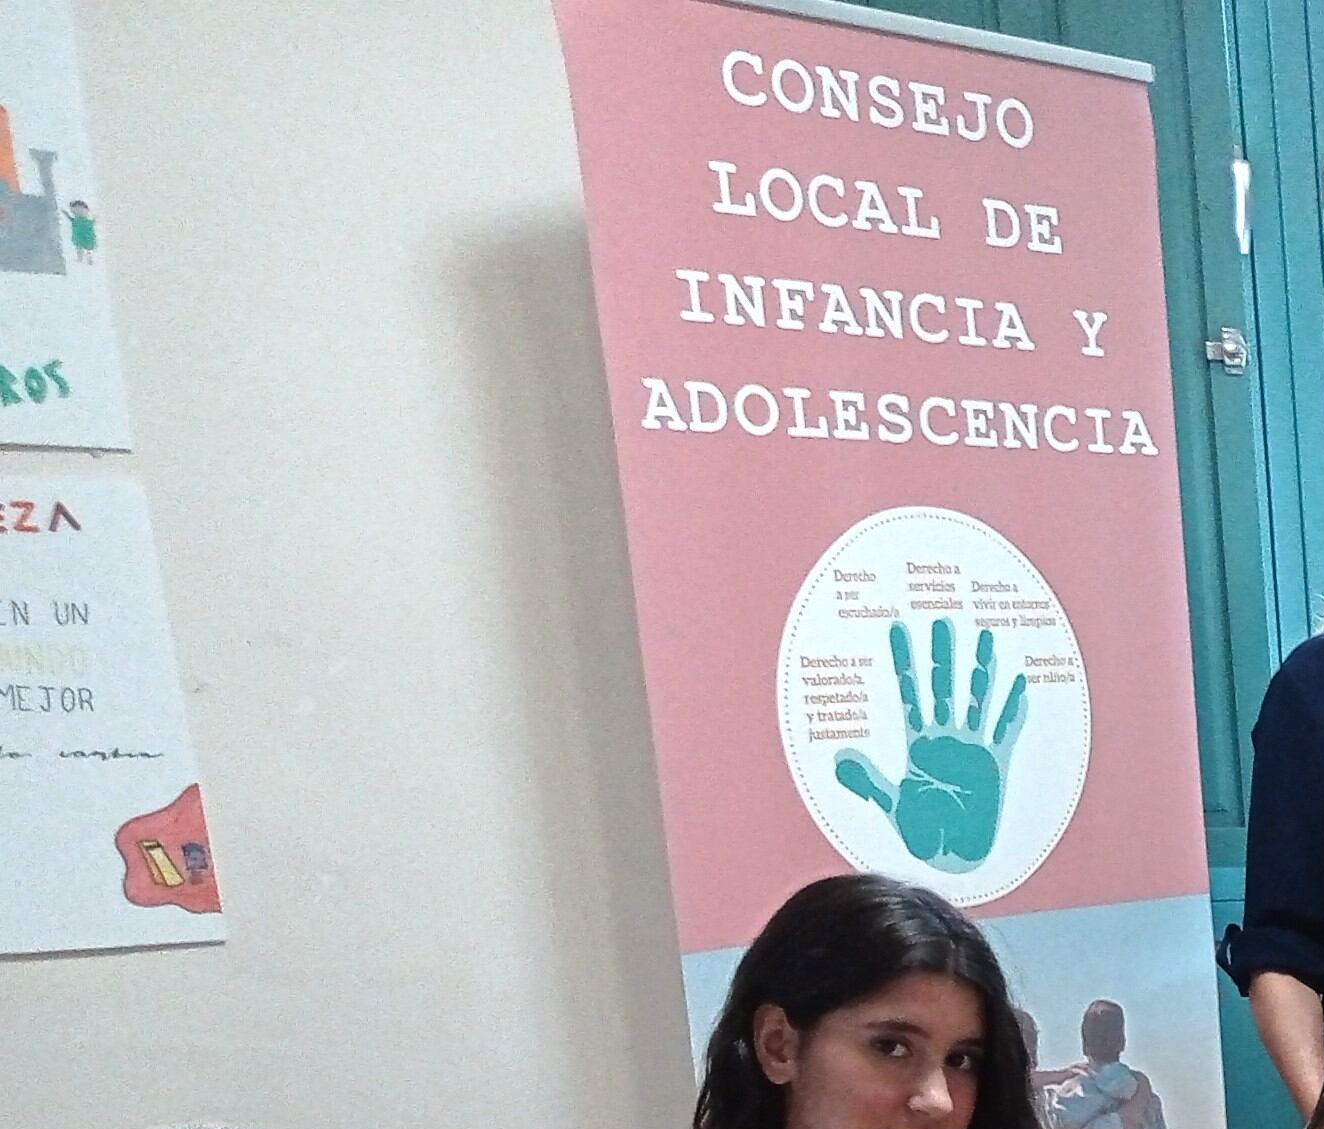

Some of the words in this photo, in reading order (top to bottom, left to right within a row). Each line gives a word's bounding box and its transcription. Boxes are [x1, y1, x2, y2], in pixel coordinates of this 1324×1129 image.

[721, 49, 1034, 149] CONSEJO
[707, 159, 941, 240] LOCAL
[981, 197, 1063, 255] DE
[675, 268, 1035, 351] INFANCIA
[1073, 309, 1108, 357] Y
[640, 376, 1160, 457] ADOLESCENCIA
[906, 561, 952, 575] Derecho
[53, 599, 89, 625] UN
[799, 655, 848, 668] Derecho
